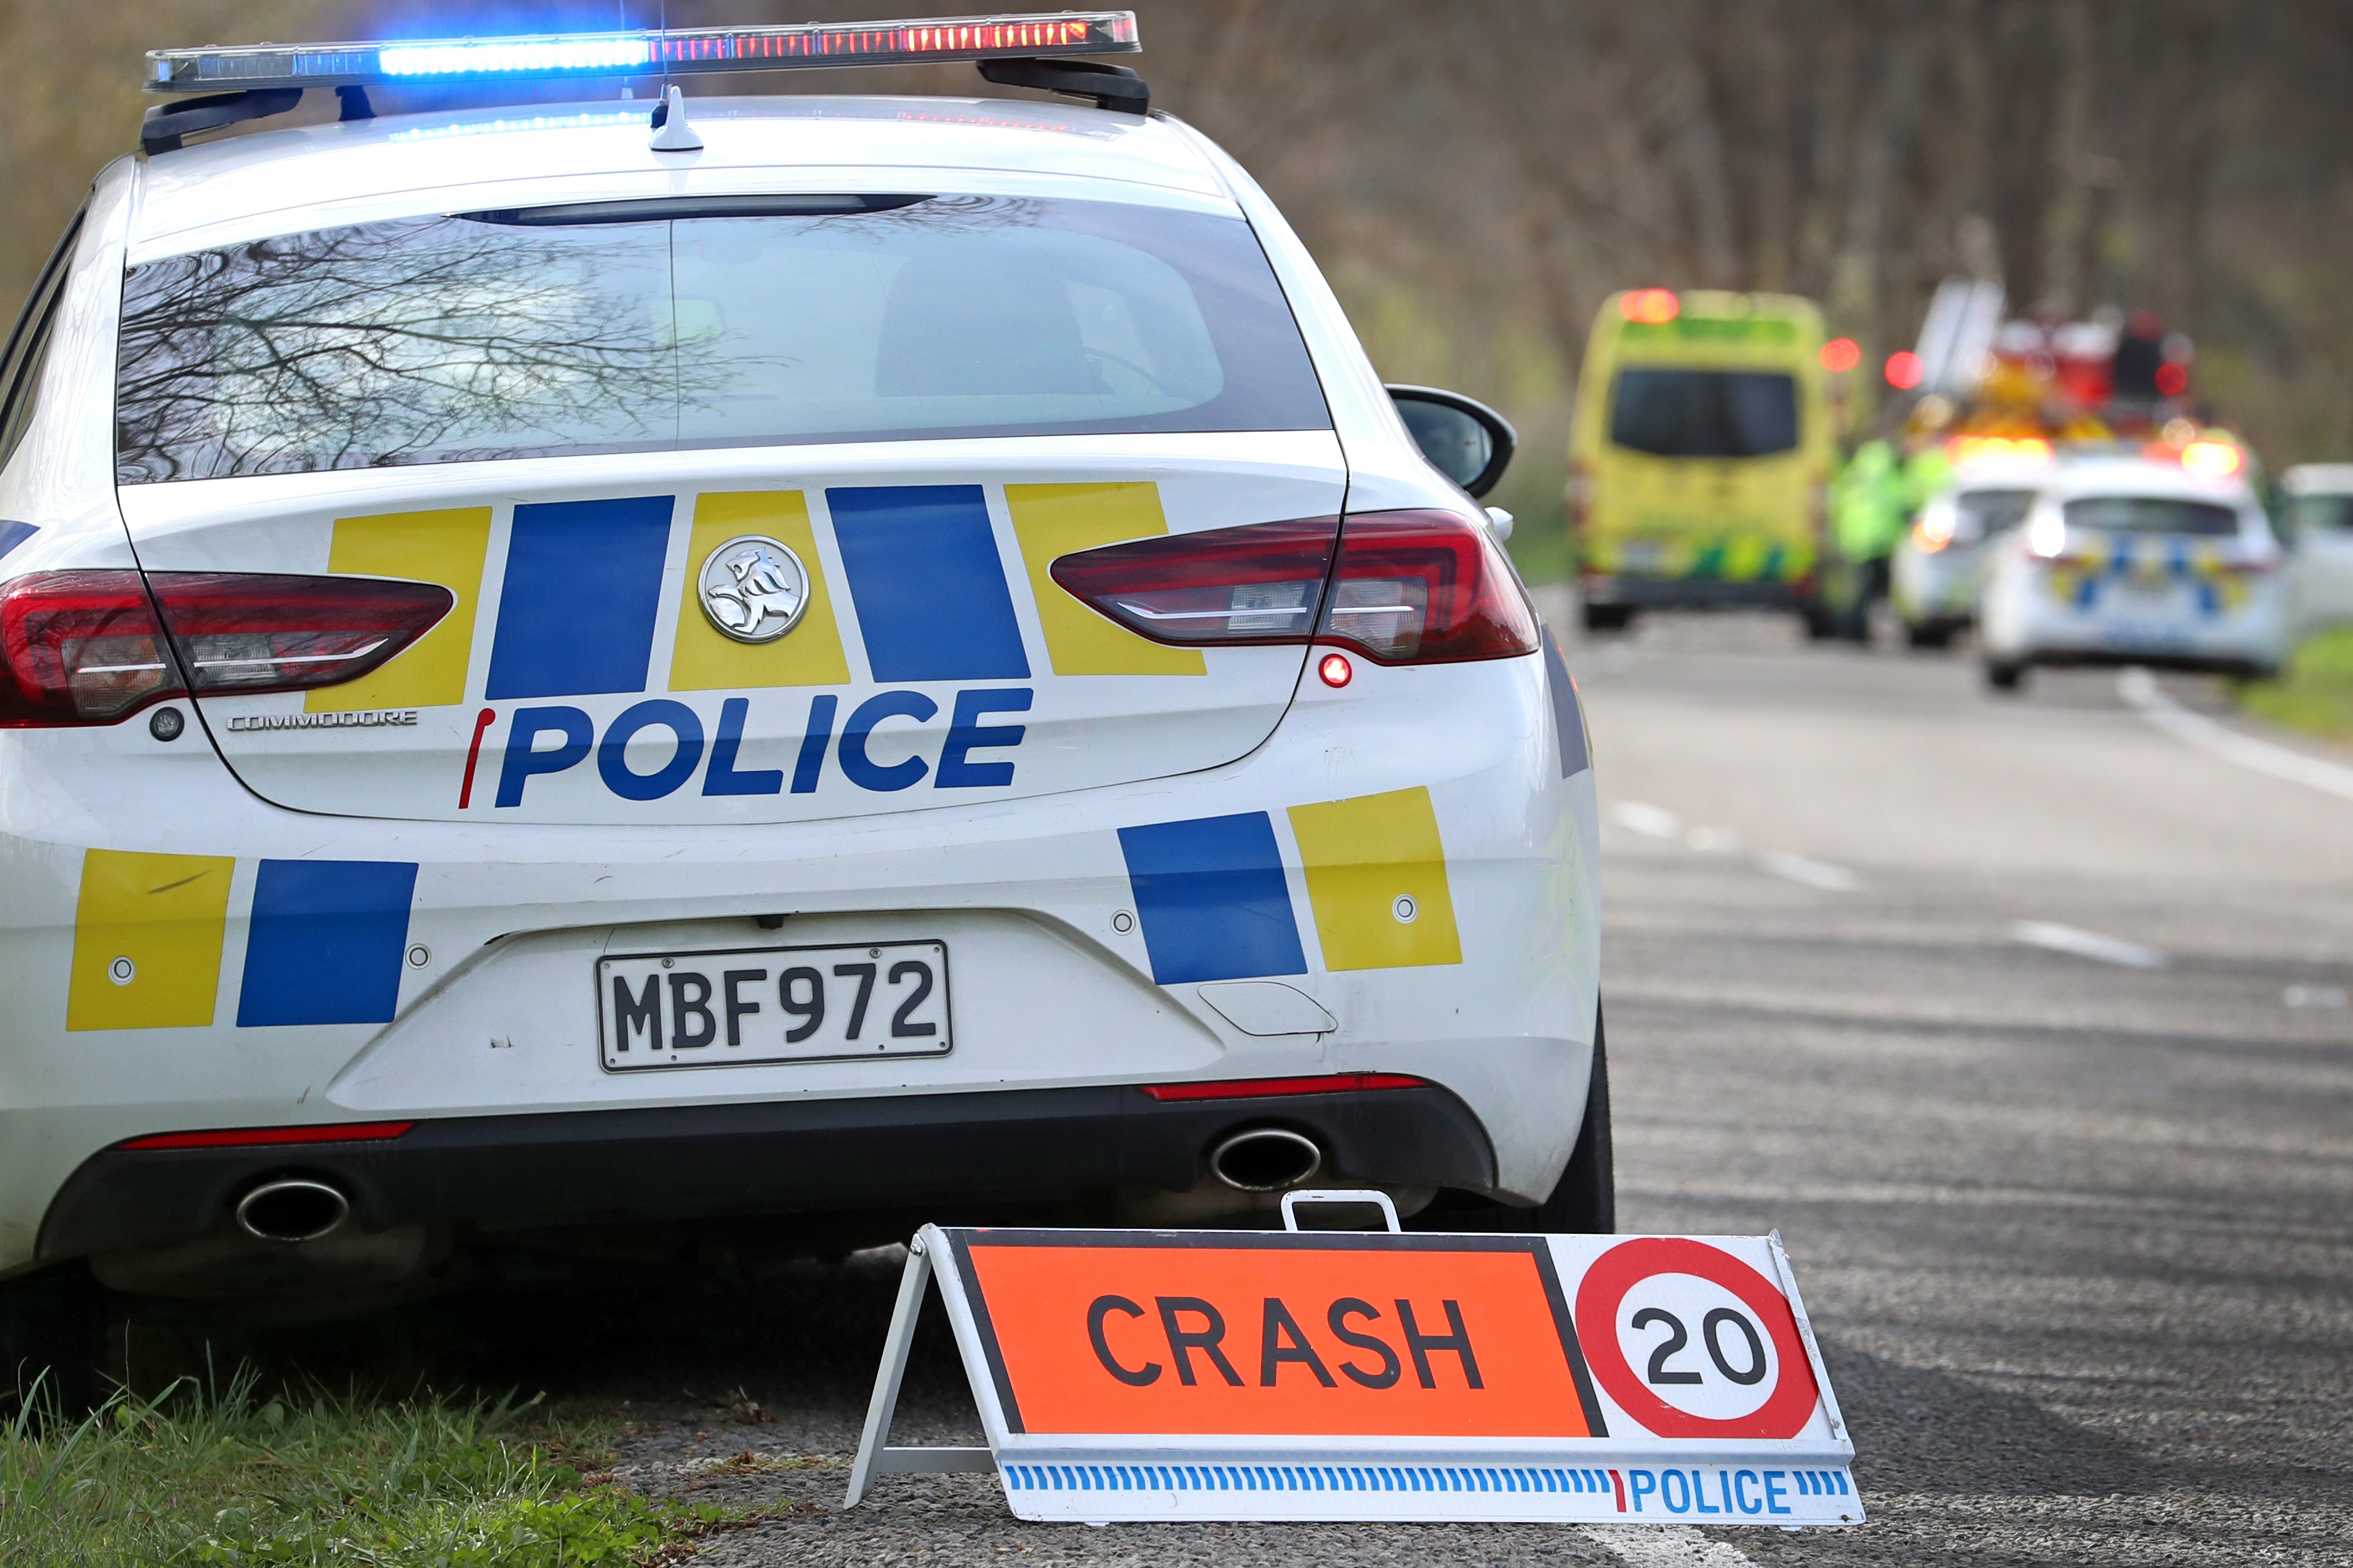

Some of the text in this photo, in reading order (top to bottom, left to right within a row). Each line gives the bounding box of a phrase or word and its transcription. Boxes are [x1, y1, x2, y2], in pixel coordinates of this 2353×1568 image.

[226, 710, 418, 732] COMMODORE
[495, 688, 1034, 808] POLICE
[613, 960, 937, 1052] MBF972
[1087, 1294, 1484, 1390] CRASH
[1631, 1307, 1767, 1385] 20
[1631, 1468, 1791, 1514] POLICE
